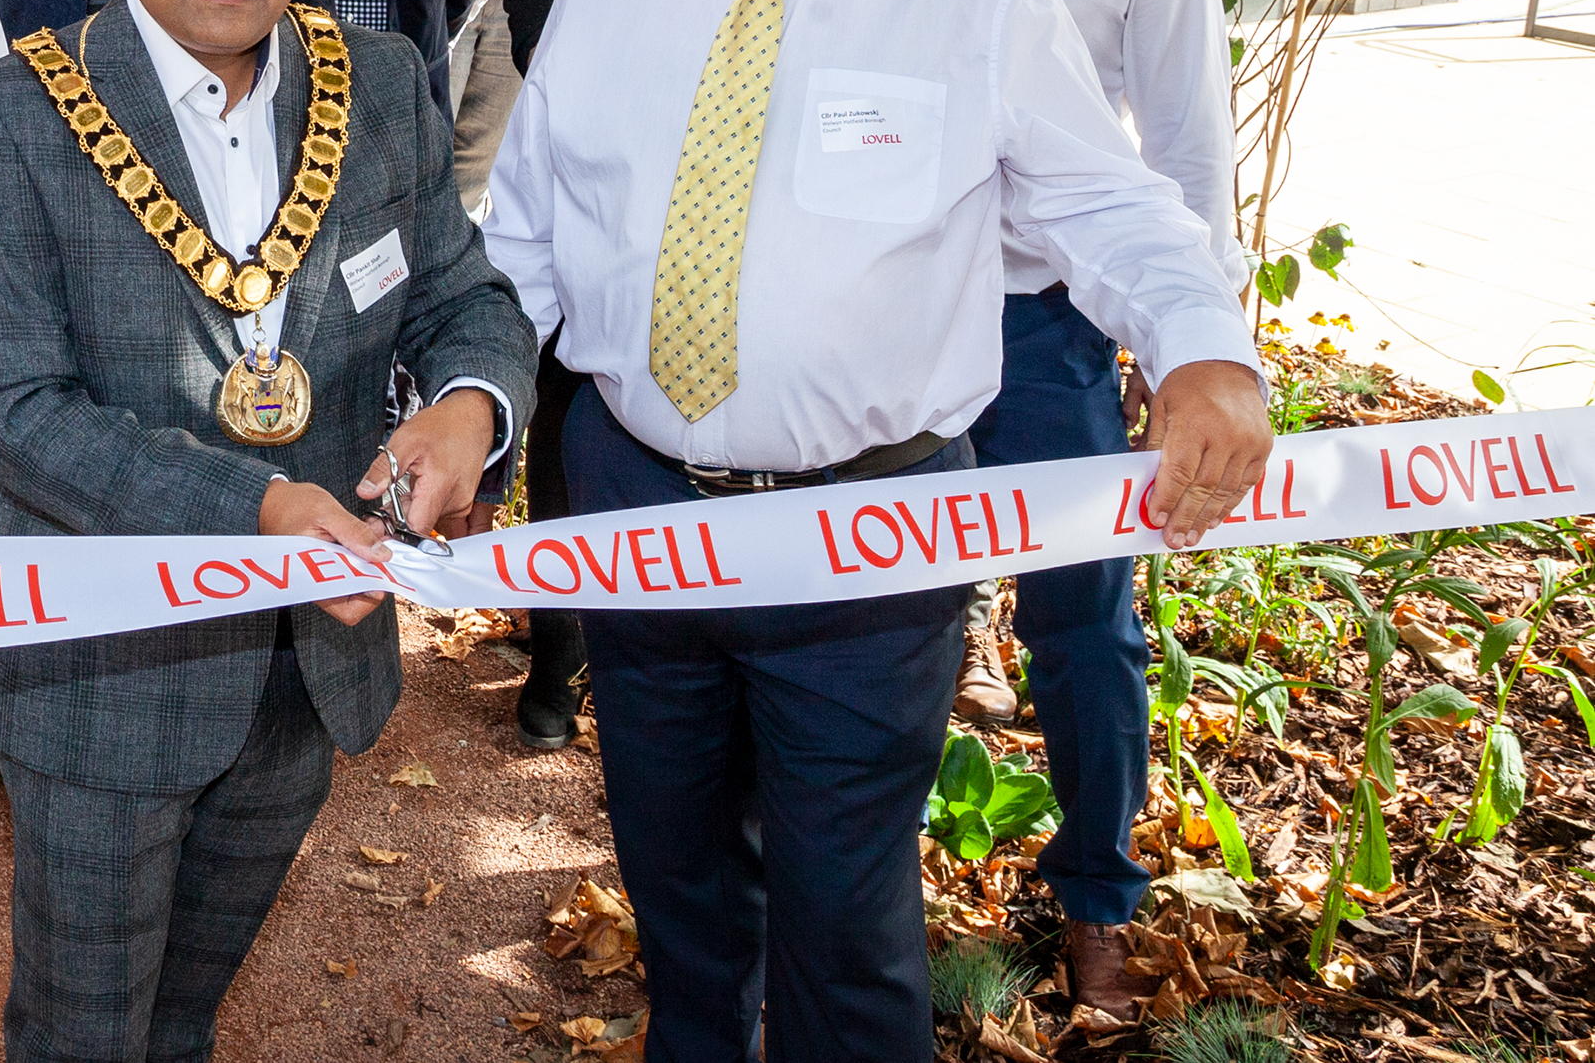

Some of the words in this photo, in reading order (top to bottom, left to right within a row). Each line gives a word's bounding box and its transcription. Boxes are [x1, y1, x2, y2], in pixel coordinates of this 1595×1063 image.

[862, 134, 902, 145] LOVELL
[355, 262, 371, 274] Pankit
[370, 254, 381, 265] Shah
[378, 266, 405, 290] LOVELL
[157, 548, 416, 607] LOVELL
[492, 522, 742, 595] LOVELL
[817, 489, 1043, 575] LOVELL
[1112, 459, 1306, 535] LLL
[1380, 434, 1575, 510] LOVELL
